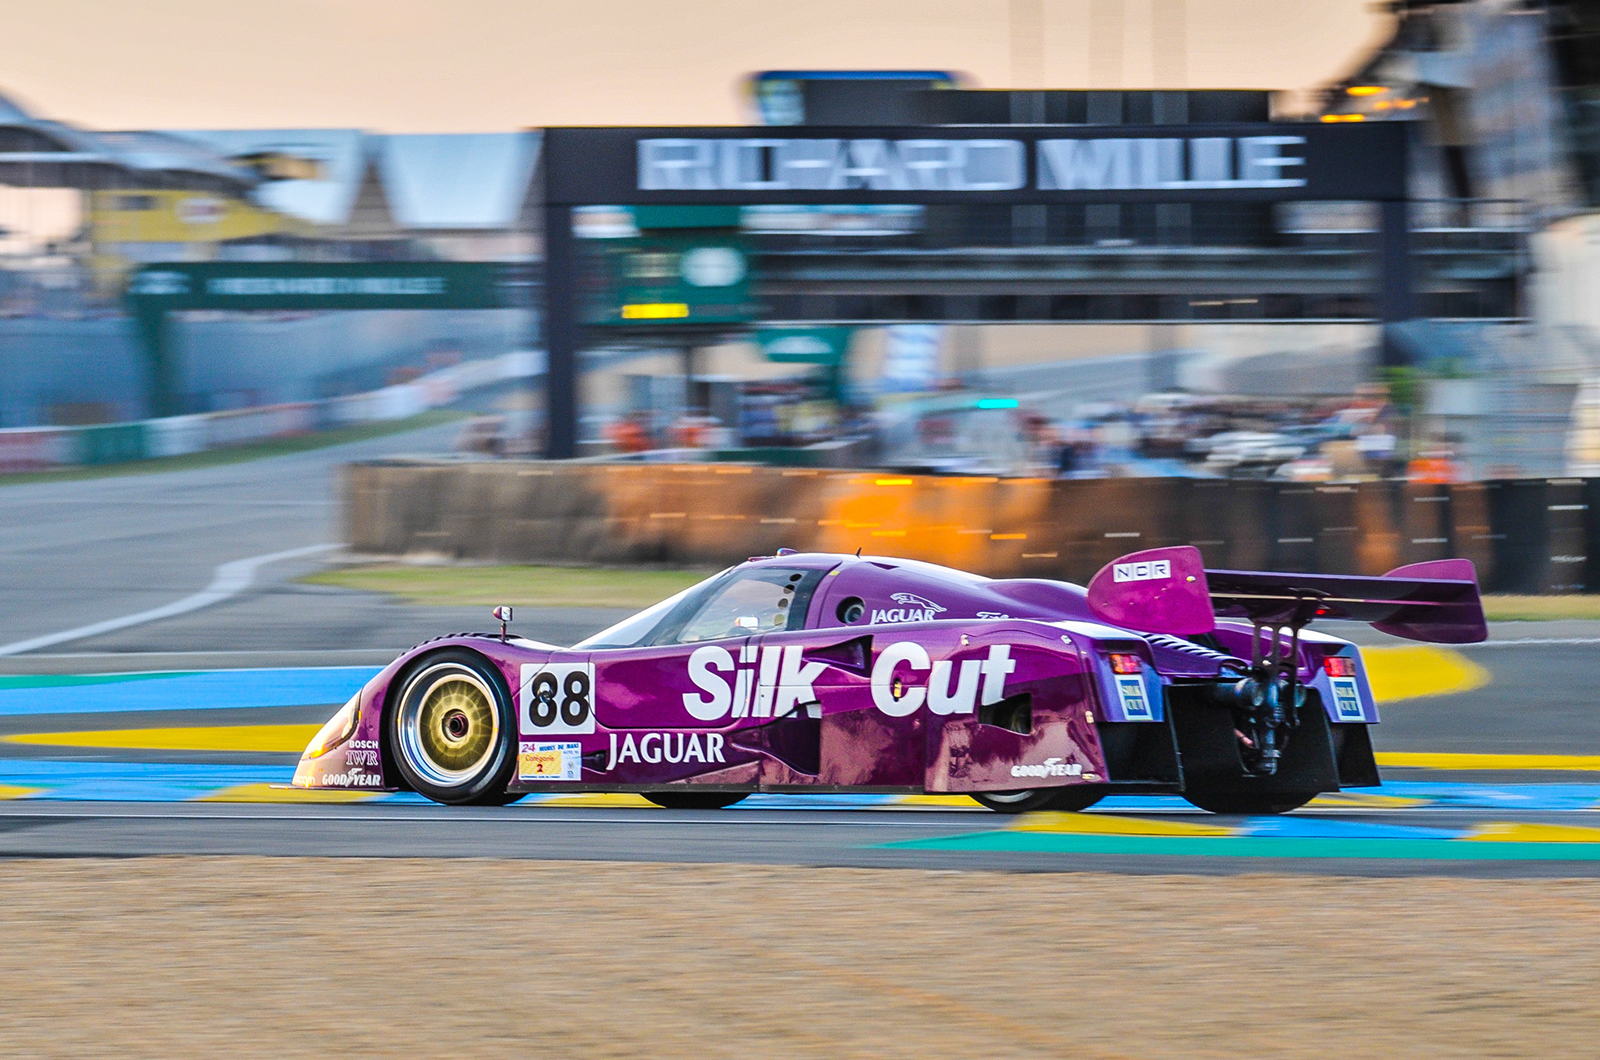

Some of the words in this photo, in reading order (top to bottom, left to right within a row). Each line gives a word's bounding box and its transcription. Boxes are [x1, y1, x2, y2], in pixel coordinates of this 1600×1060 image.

[1117, 564, 1166, 579] NCR
[869, 608, 936, 625] JAGUAR
[682, 645, 829, 720] Silk
[871, 642, 1017, 717] Cut
[529, 671, 591, 727] 88
[349, 740, 379, 749] BOSCH
[521, 743, 535, 753] 24
[606, 733, 726, 771] JAGUAR
[536, 763, 543, 773] 2
